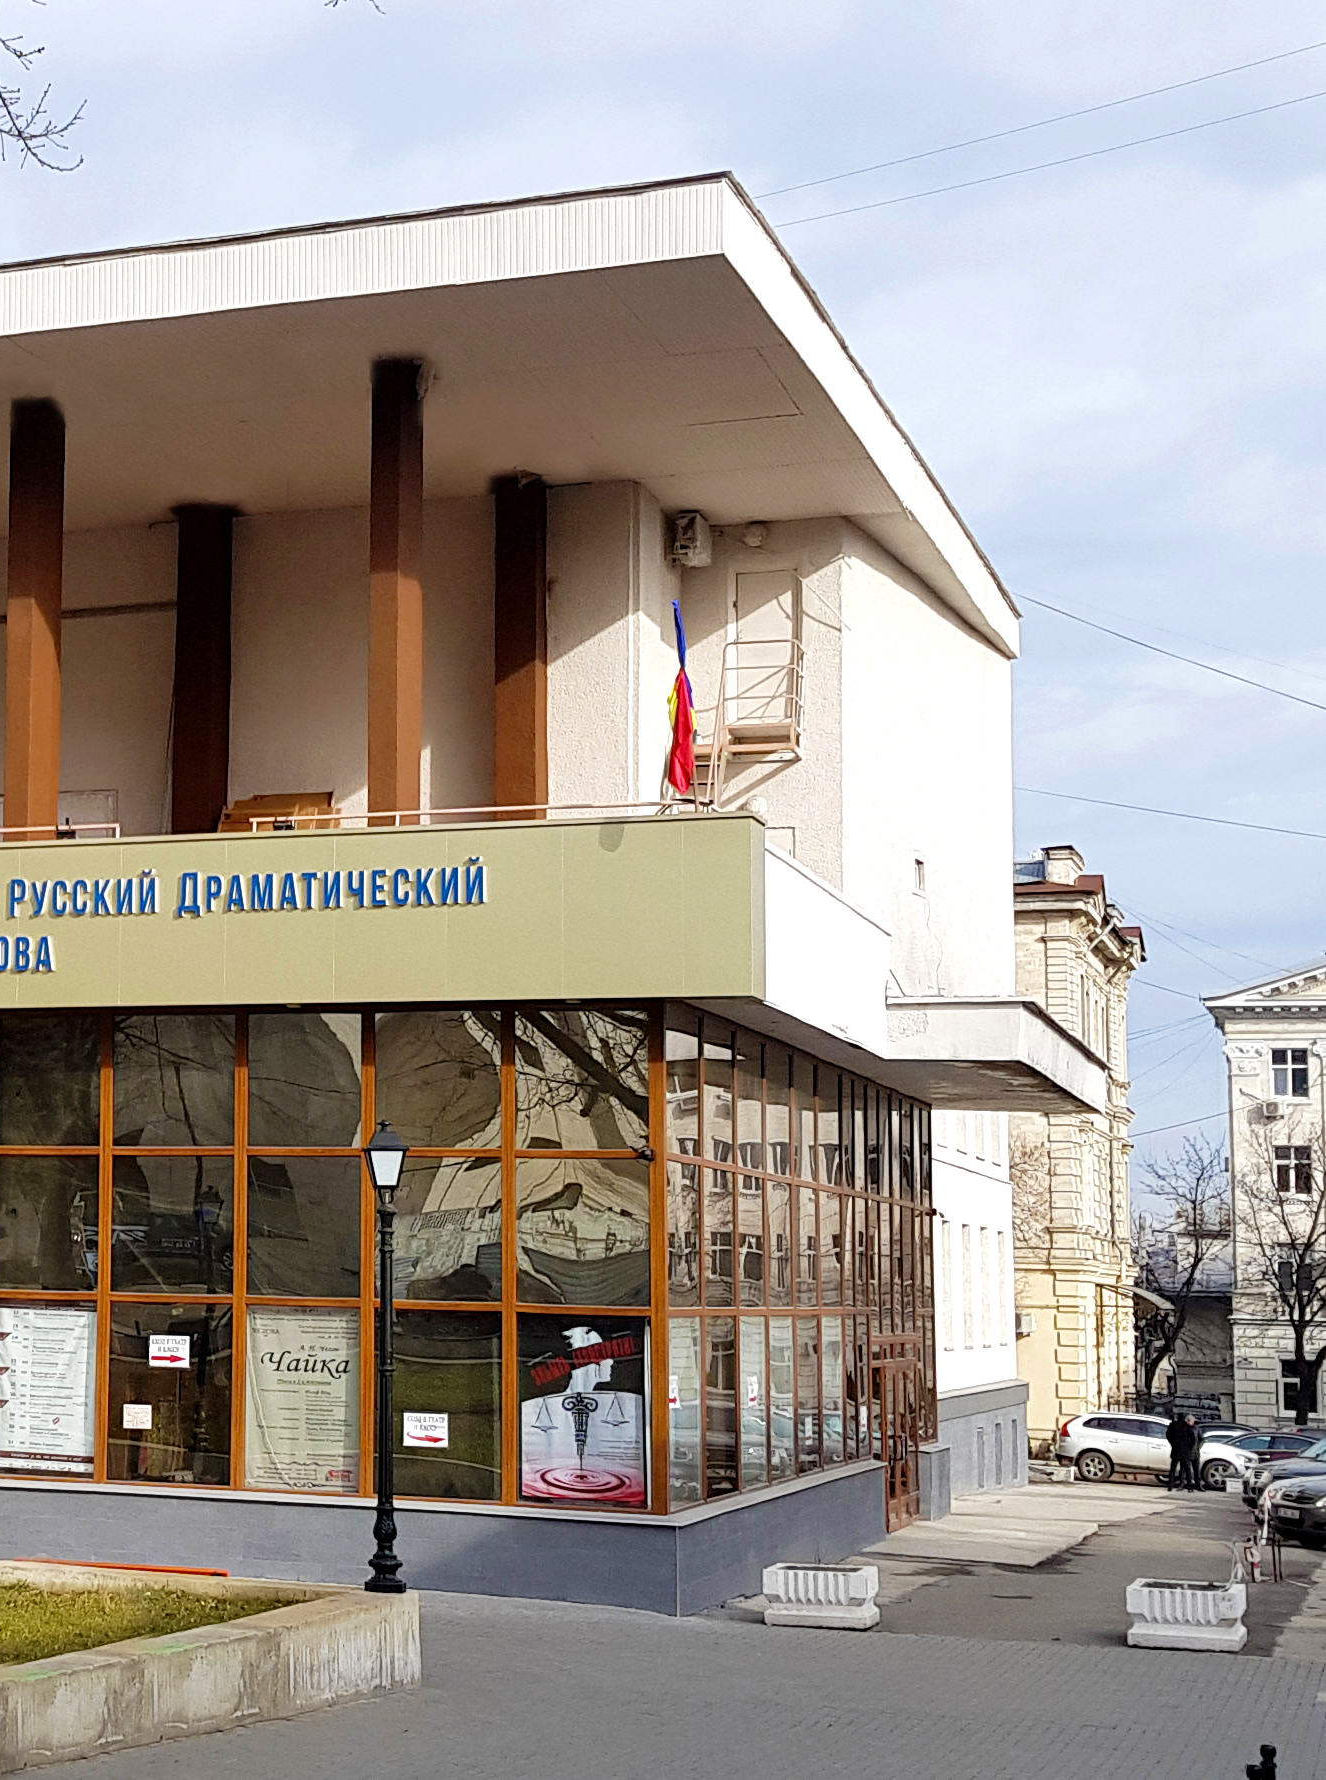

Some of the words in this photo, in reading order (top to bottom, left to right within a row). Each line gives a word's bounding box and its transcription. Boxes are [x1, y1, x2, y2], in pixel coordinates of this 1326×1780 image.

[8, 868, 160, 918] РУССКИЙ
[176, 856, 488, 918] ДРАМАТИЧЕСКИЙ
[260, 1350, 351, 1379] Чайка
